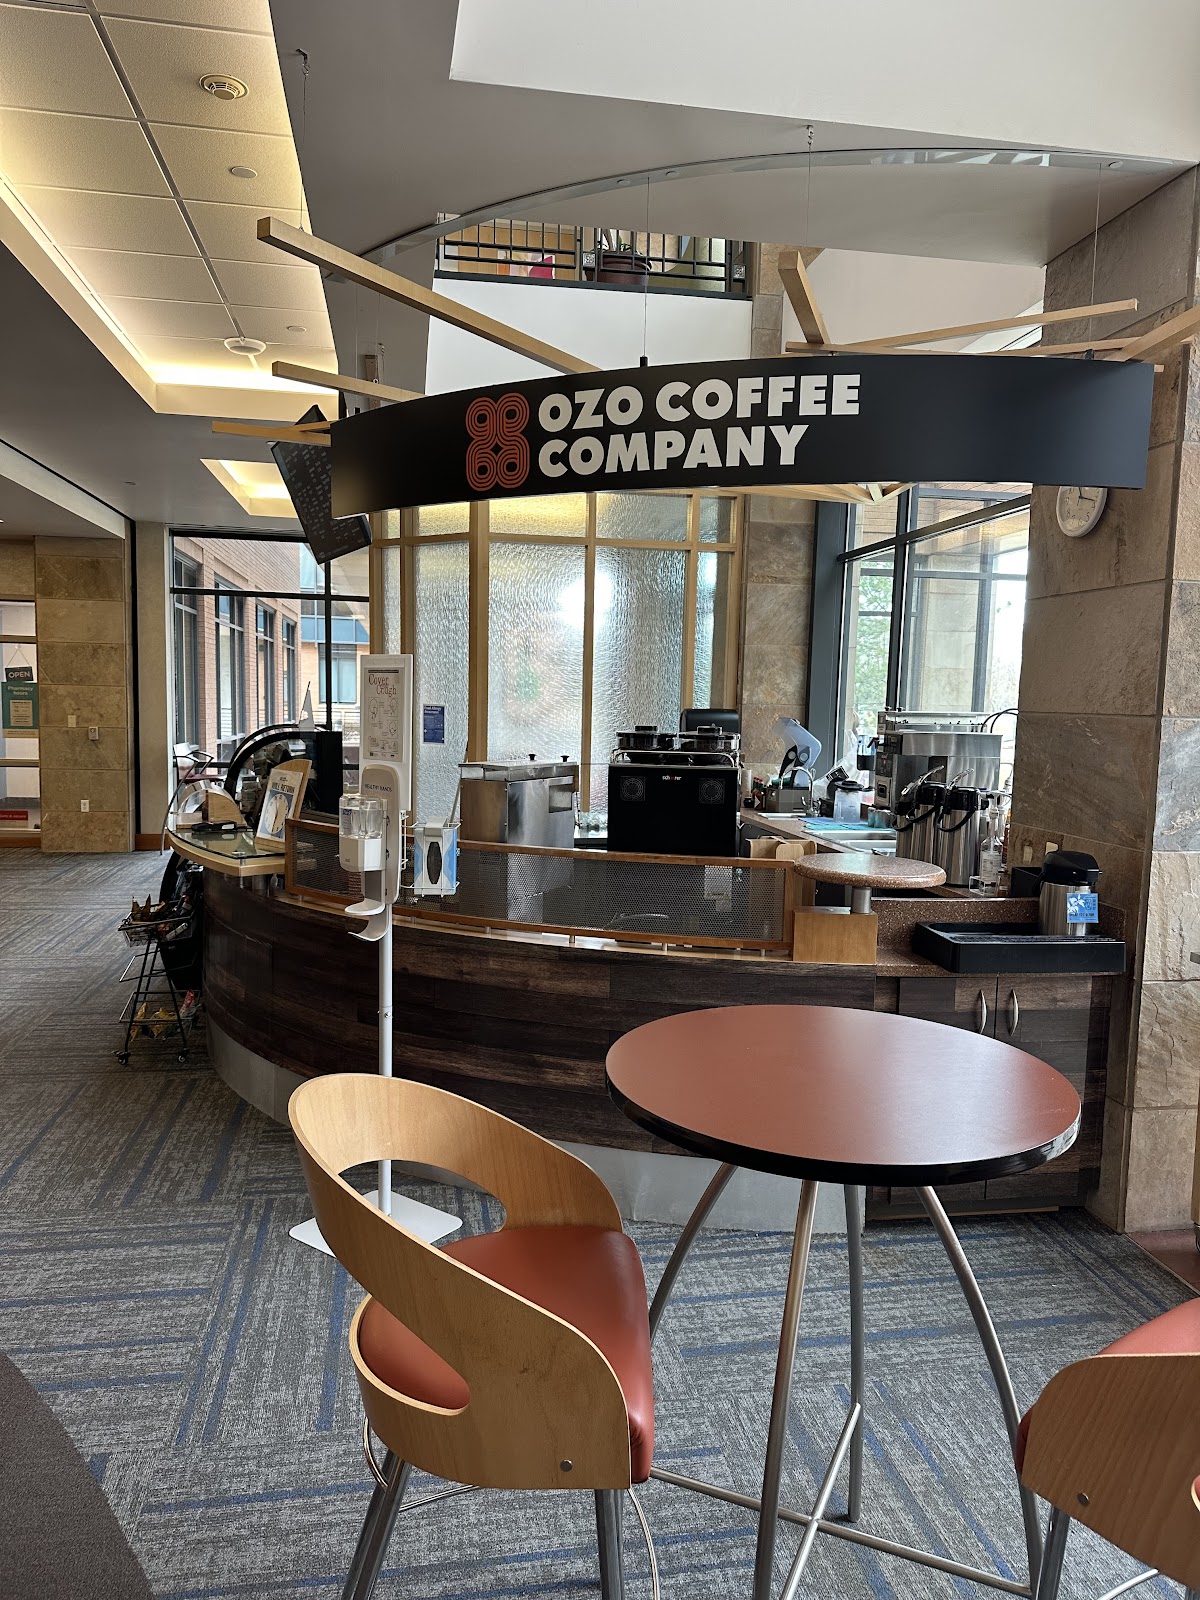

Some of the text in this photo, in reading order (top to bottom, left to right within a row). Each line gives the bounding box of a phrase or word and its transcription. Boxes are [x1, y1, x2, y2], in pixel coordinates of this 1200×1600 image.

[538, 374, 861, 433] OZO COFFEE
[538, 424, 809, 477] COMPANY
[369, 674, 389, 686] Cover
[376, 685, 397, 697] Cough
[281, 784, 295, 794] RETURN
